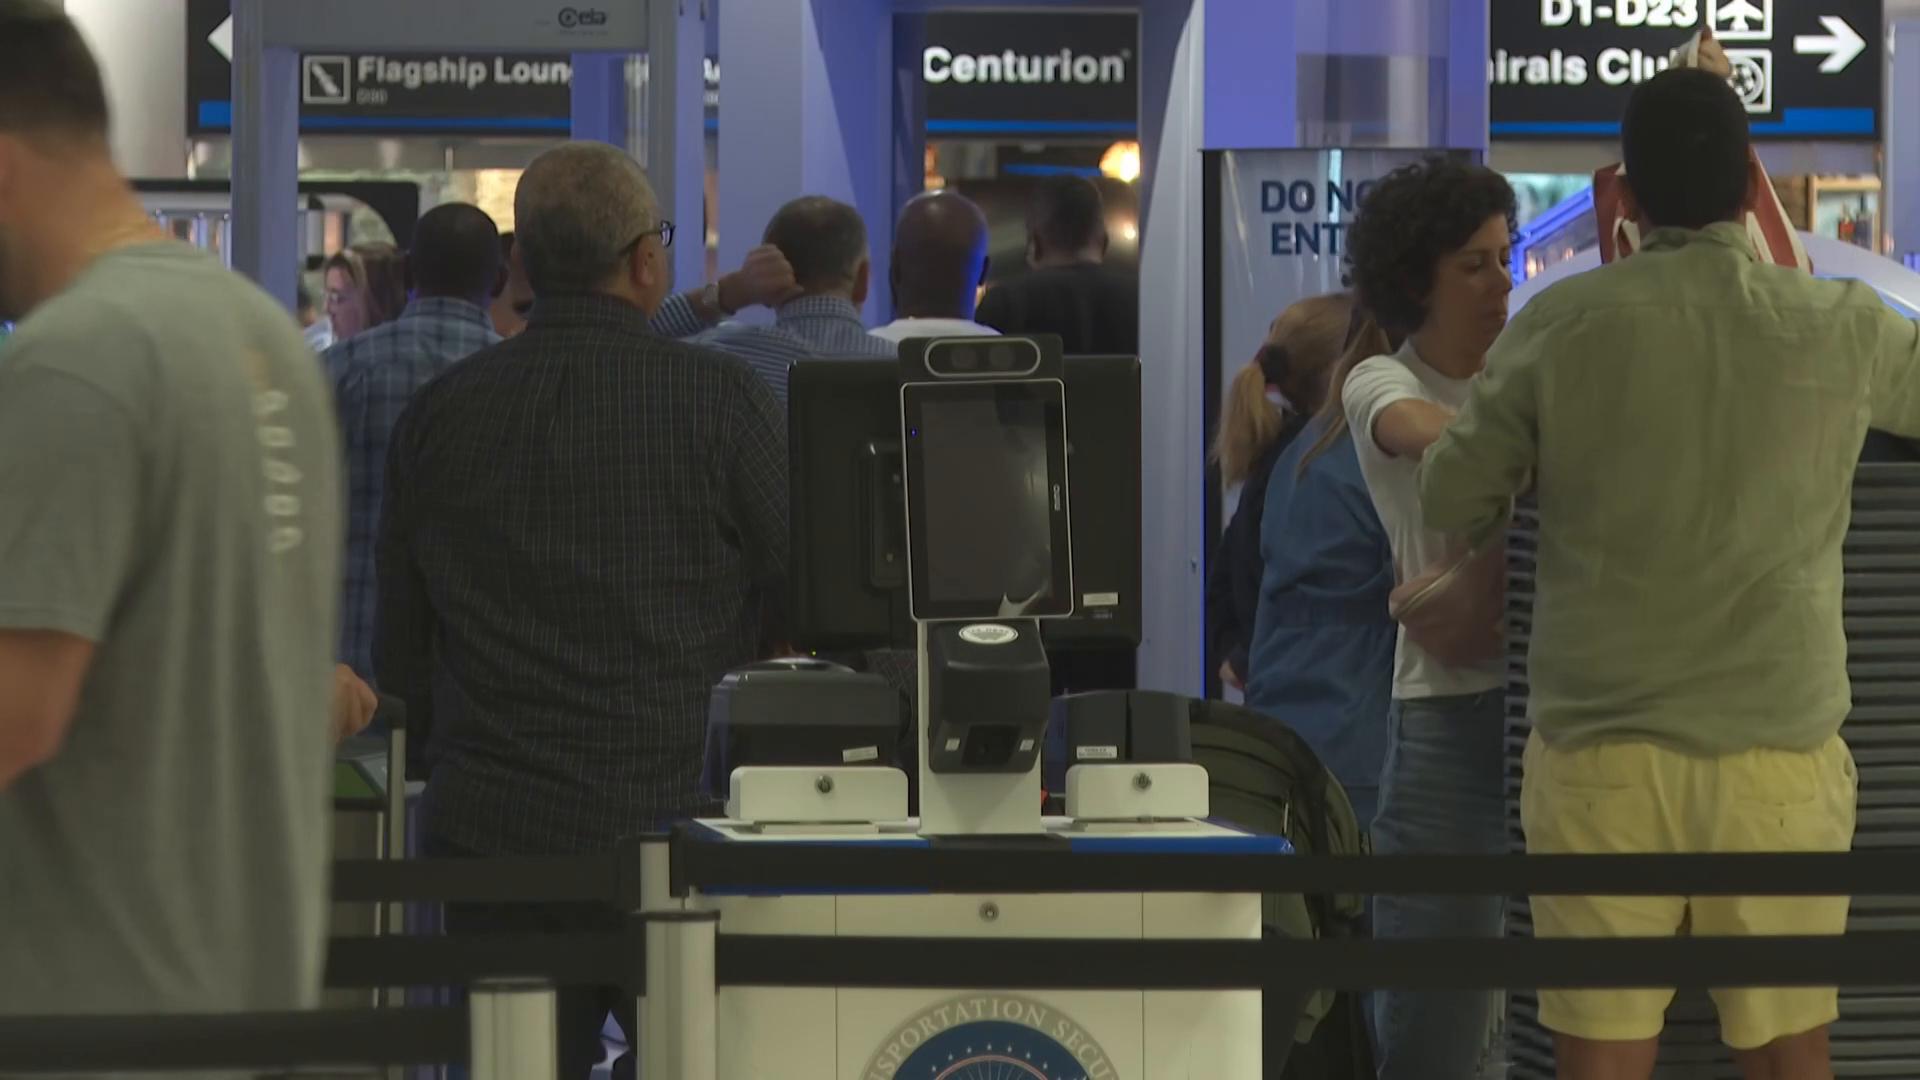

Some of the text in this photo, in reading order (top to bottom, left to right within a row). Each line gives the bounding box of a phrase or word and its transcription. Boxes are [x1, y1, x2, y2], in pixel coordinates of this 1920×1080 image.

[1540, 0, 1698, 26] D1-D23
[358, 56, 573, 89] Flagship Loun
[923, 46, 1124, 83] Centurion
[1261, 180, 1315, 213] DO
[1271, 222, 1345, 255] ENT
[869, 998, 1114, 1080] SPORTATION SECU
